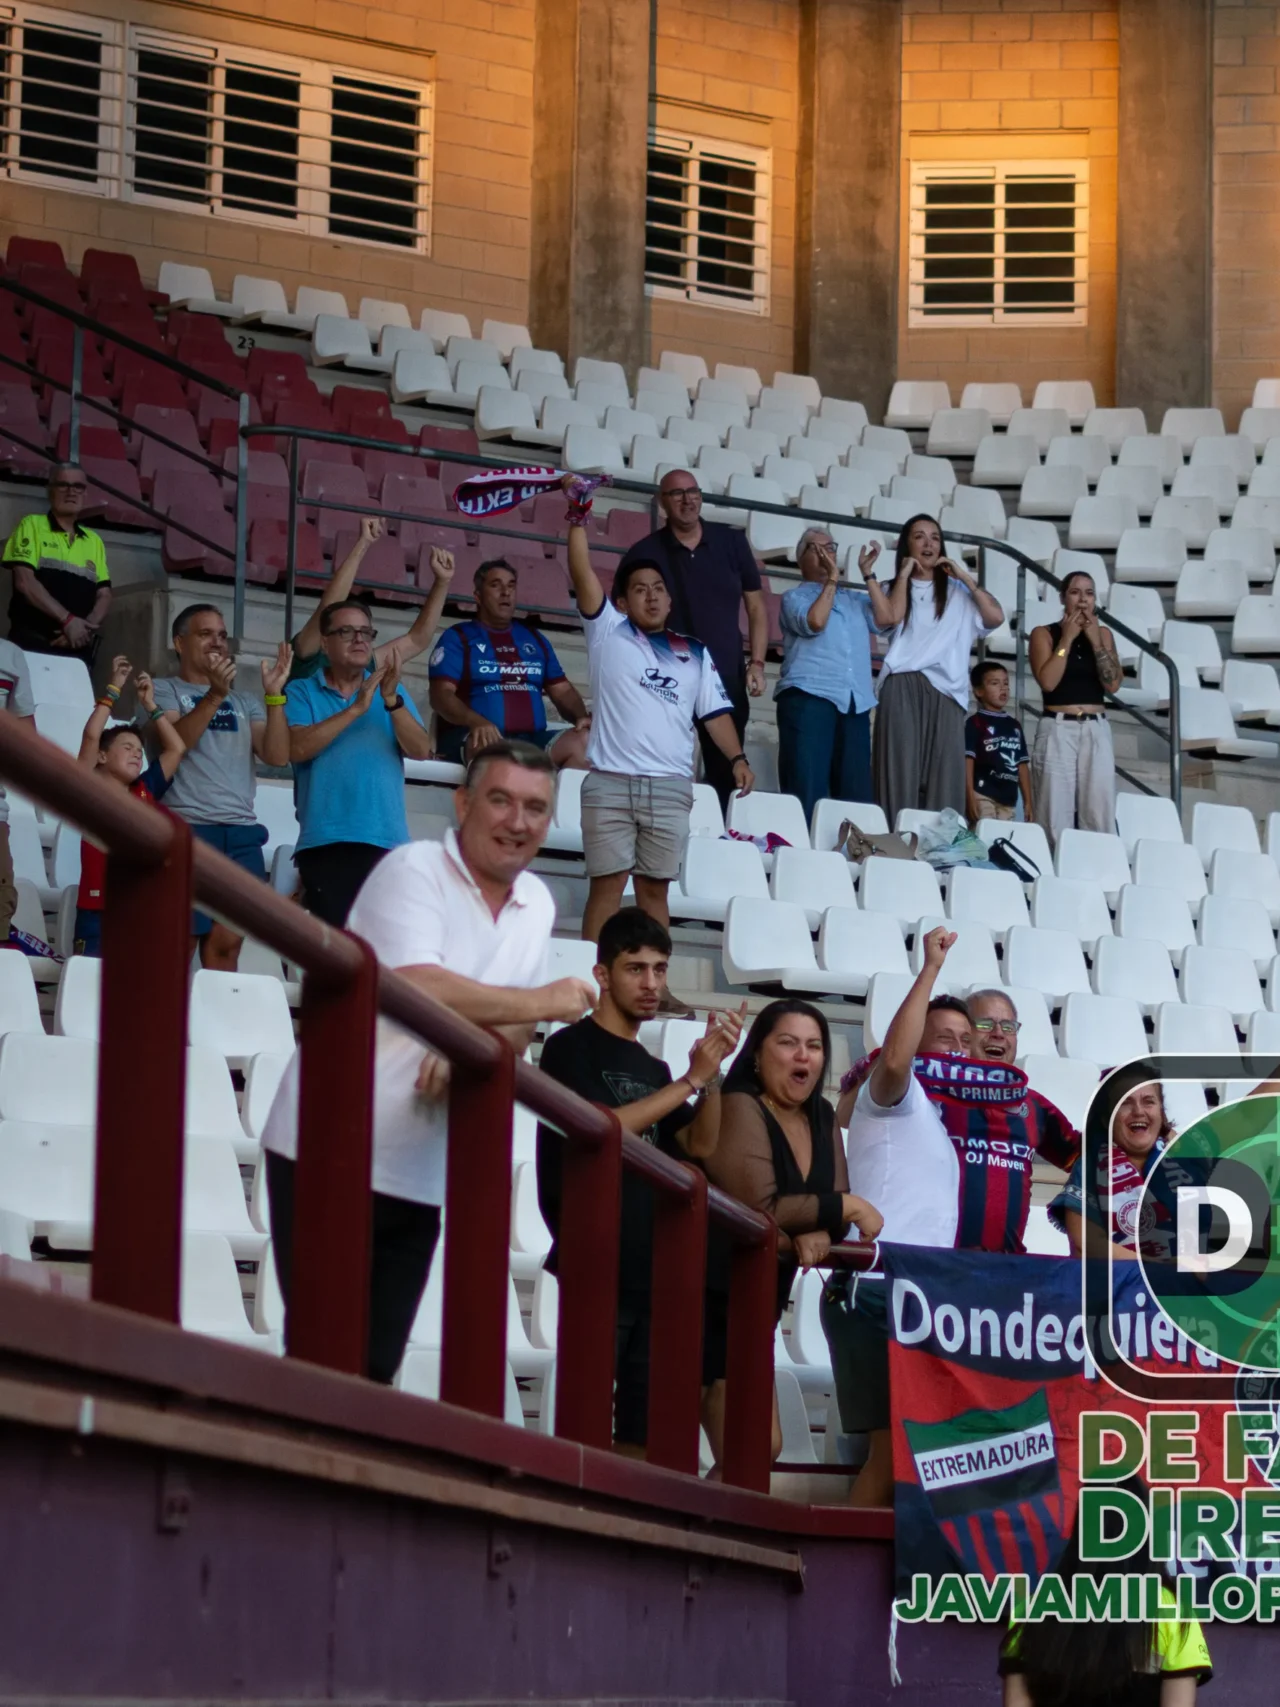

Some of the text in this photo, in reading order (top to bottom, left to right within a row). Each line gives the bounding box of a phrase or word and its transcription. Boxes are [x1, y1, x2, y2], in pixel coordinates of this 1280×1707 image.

[237, 335, 255, 350] 23
[479, 665, 542, 676] OJ MAVEN
[965, 1151, 1026, 1172] OJ Maven
[920, 1432, 1051, 1483] EXTREMADURA
